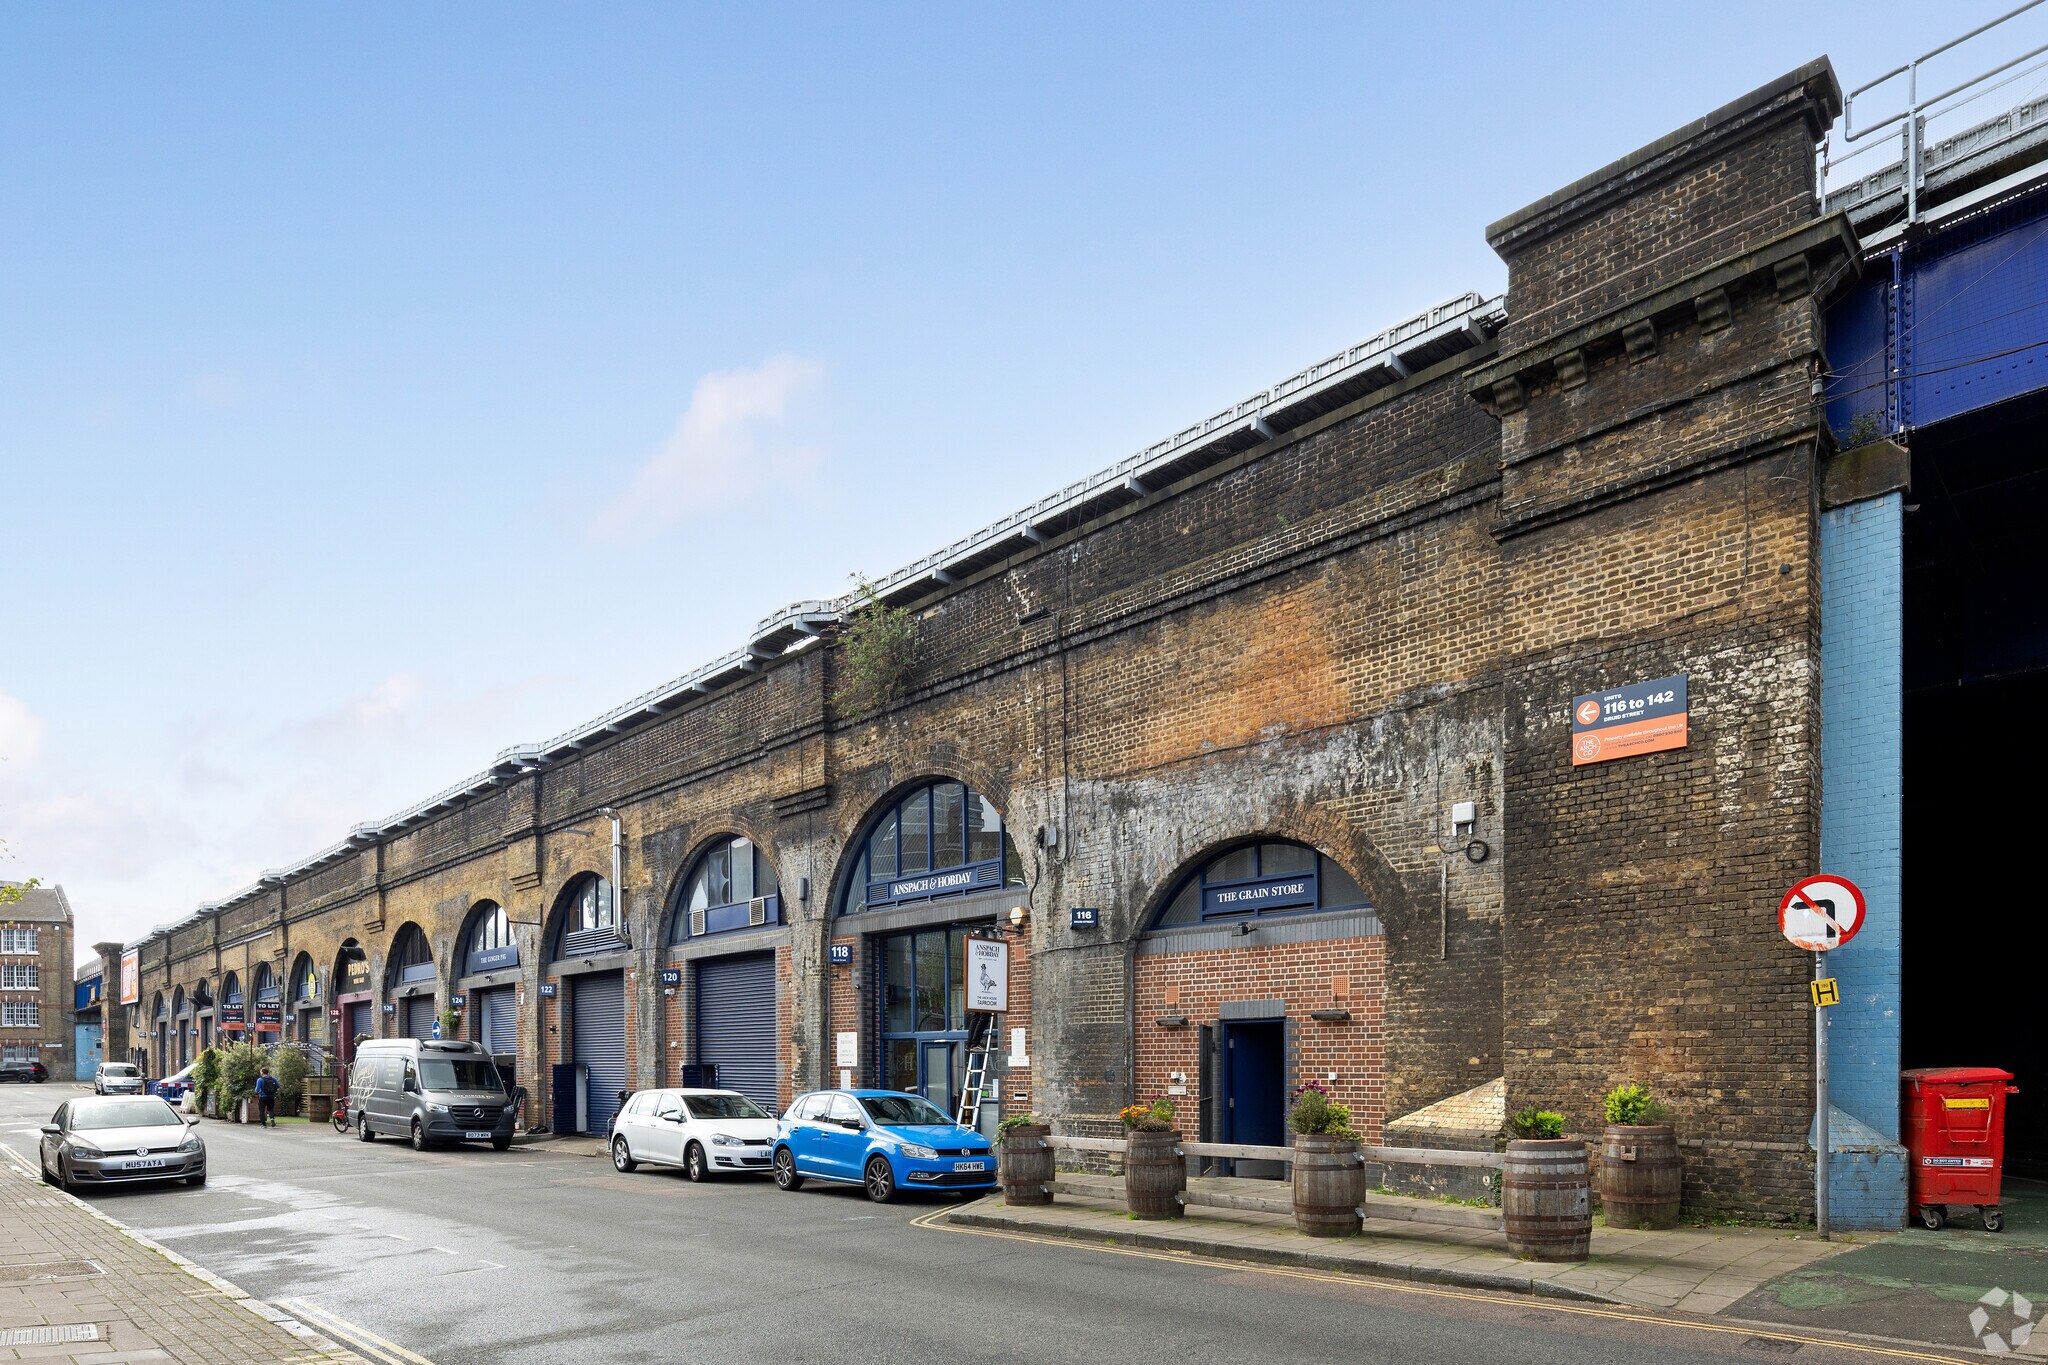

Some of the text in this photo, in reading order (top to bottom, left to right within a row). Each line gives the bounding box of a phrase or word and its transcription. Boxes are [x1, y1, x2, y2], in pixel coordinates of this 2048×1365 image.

[1604, 694, 1621, 702] UNITS
[1604, 690, 1674, 714] 116 to 142
[1604, 710, 1644, 722] DRUID STREET
[1579, 744, 1597, 752] ARCH
[893, 872, 971, 895] ANSPACH & HOBDAY
[1217, 883, 1305, 903] THE GRAIN STORE
[1076, 911, 1092, 919] 116
[832, 946, 848, 958] 118
[976, 944, 1000, 952] ANSPACH
[347, 961, 370, 976] PEDRO'S
[663, 973, 677, 981] 120
[1816, 981, 1835, 1004] H
